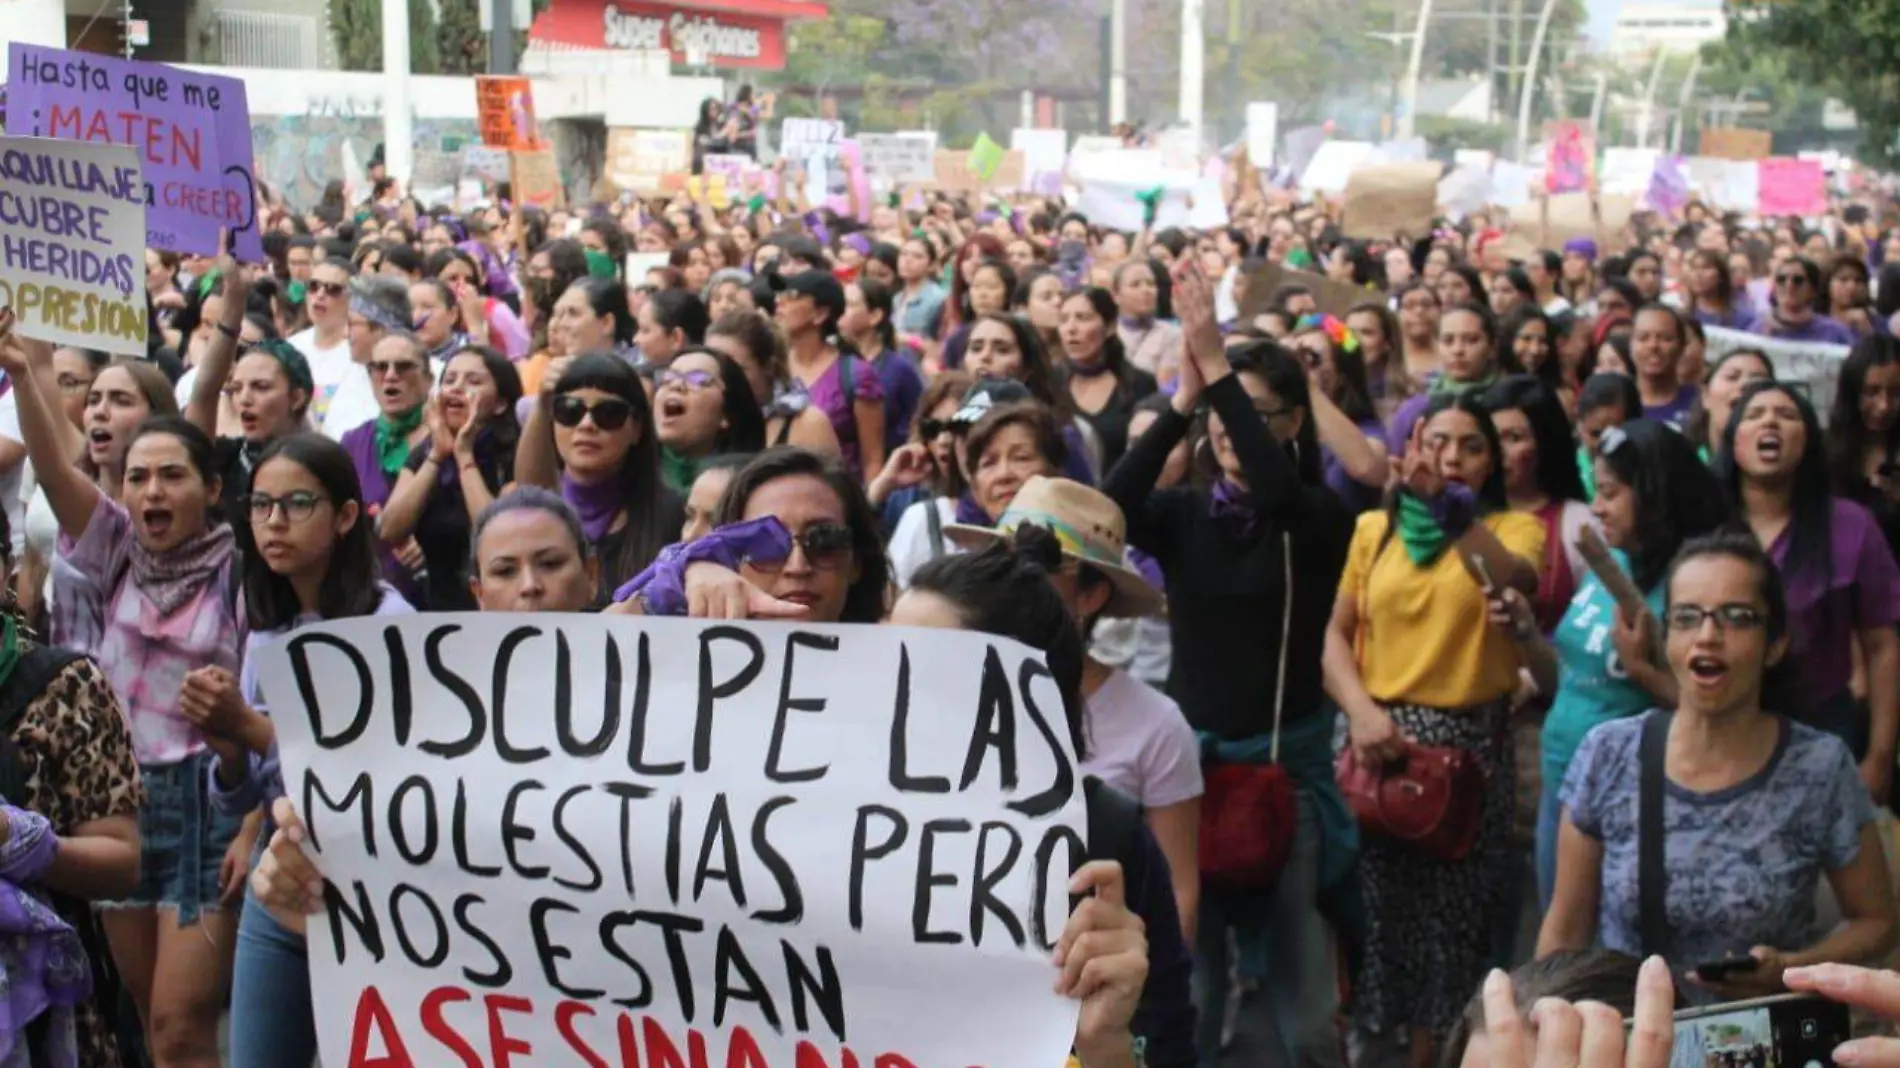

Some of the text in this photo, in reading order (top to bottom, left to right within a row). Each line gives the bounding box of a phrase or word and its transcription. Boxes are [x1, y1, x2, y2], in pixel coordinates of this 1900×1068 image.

[604, 4, 665, 49] Super
[21, 52, 222, 112] Hasta que me
[0, 190, 112, 245] CUBRE
[3, 233, 134, 295] HERIDAS
[286, 623, 1075, 819] DISCULPE LAS
[303, 766, 1093, 952] MOLESTIAS PERO
[321, 878, 846, 1042] NOS ESTAN
[347, 984, 988, 1068] ASESIN
